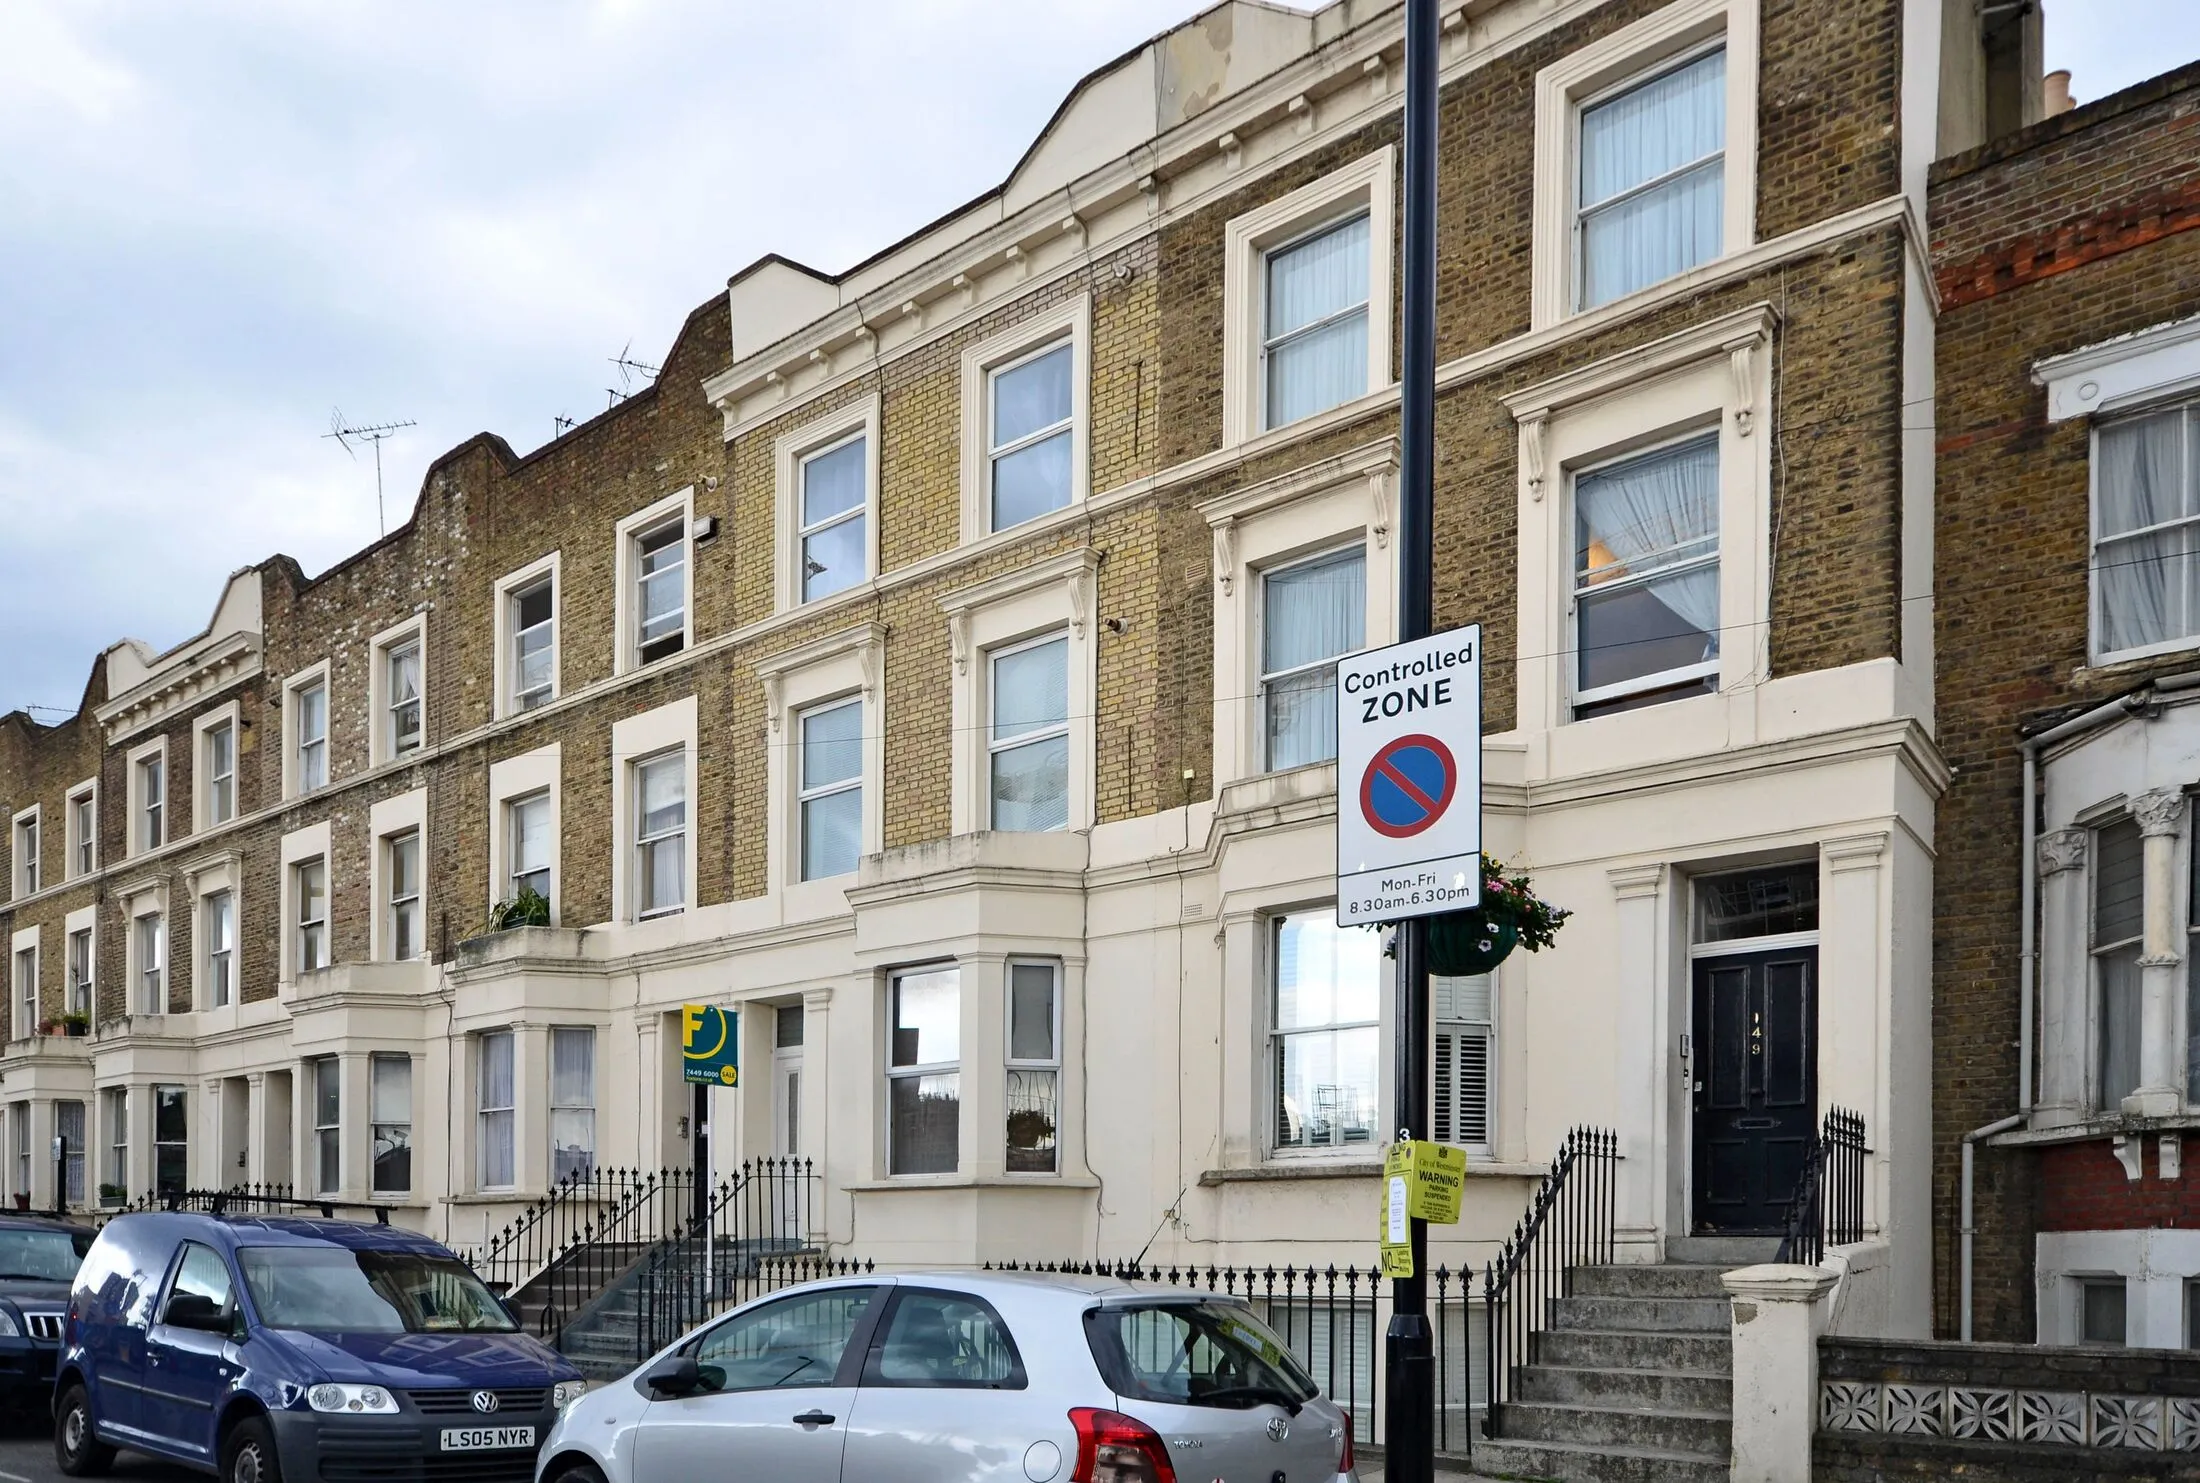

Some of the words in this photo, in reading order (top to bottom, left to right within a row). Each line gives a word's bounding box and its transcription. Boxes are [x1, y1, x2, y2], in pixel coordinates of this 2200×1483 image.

[1344, 641, 1472, 694] Controlled
[1362, 677, 1452, 724] ZONE
[1381, 872, 1436, 892] Mon-Fri
[1349, 887, 1470, 914] 8.30am-6.30pm
[683, 1004, 707, 1048] F
[686, 1068, 702, 1077] 7449
[703, 1070, 720, 1078] 6000
[721, 1071, 736, 1079] SALE
[1399, 1127, 1411, 1144] 3
[1419, 1169, 1459, 1188] WARNING
[1424, 1191, 1452, 1202] SUSPENDED
[1428, 1184, 1449, 1194] PARKING
[1381, 1251, 1393, 1273] NO
[447, 1430, 493, 1448] LS05
[498, 1429, 529, 1446] NYR
